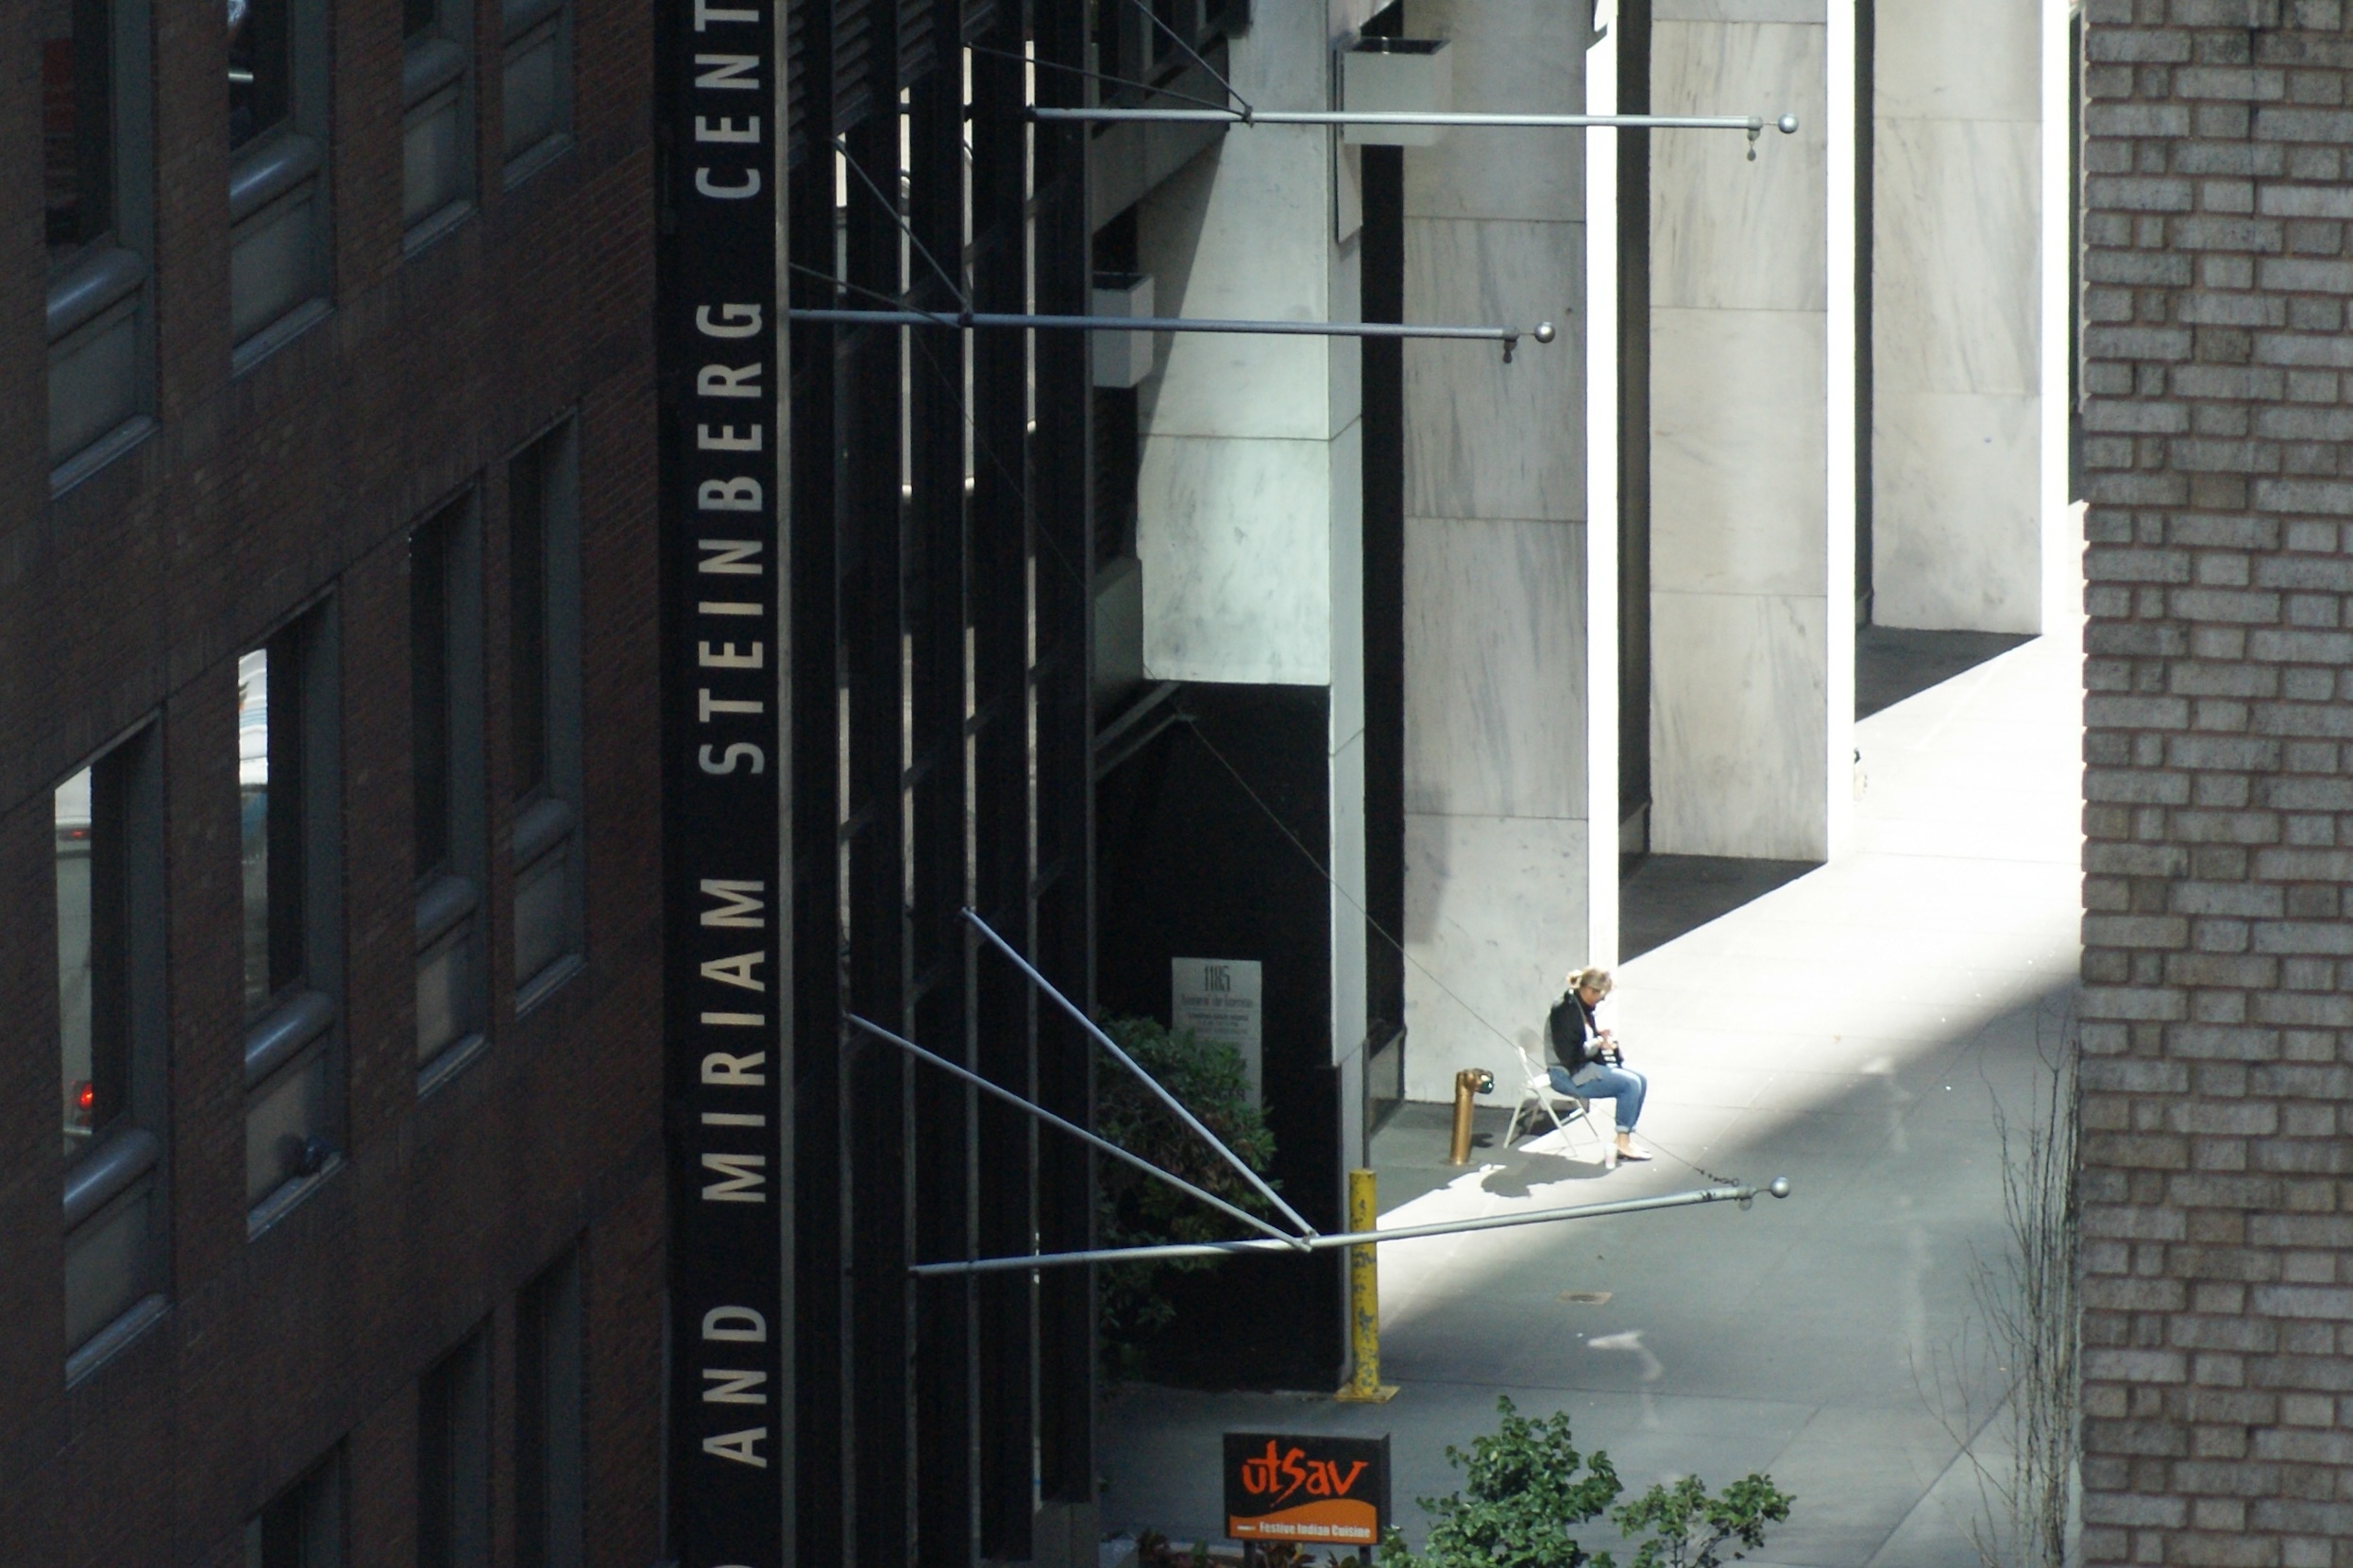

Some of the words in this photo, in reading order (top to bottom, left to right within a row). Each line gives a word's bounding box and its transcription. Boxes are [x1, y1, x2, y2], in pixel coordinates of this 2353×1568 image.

[694, 0, 760, 198] CENT
[696, 303, 764, 774] STEINBERG
[700, 879, 766, 1202] MIRIAM
[703, 1307, 767, 1467] AND
[1259, 1521, 1296, 1536] Festive
[1297, 1523, 1330, 1537] Indian
[1331, 1524, 1371, 1539] Cuisine
